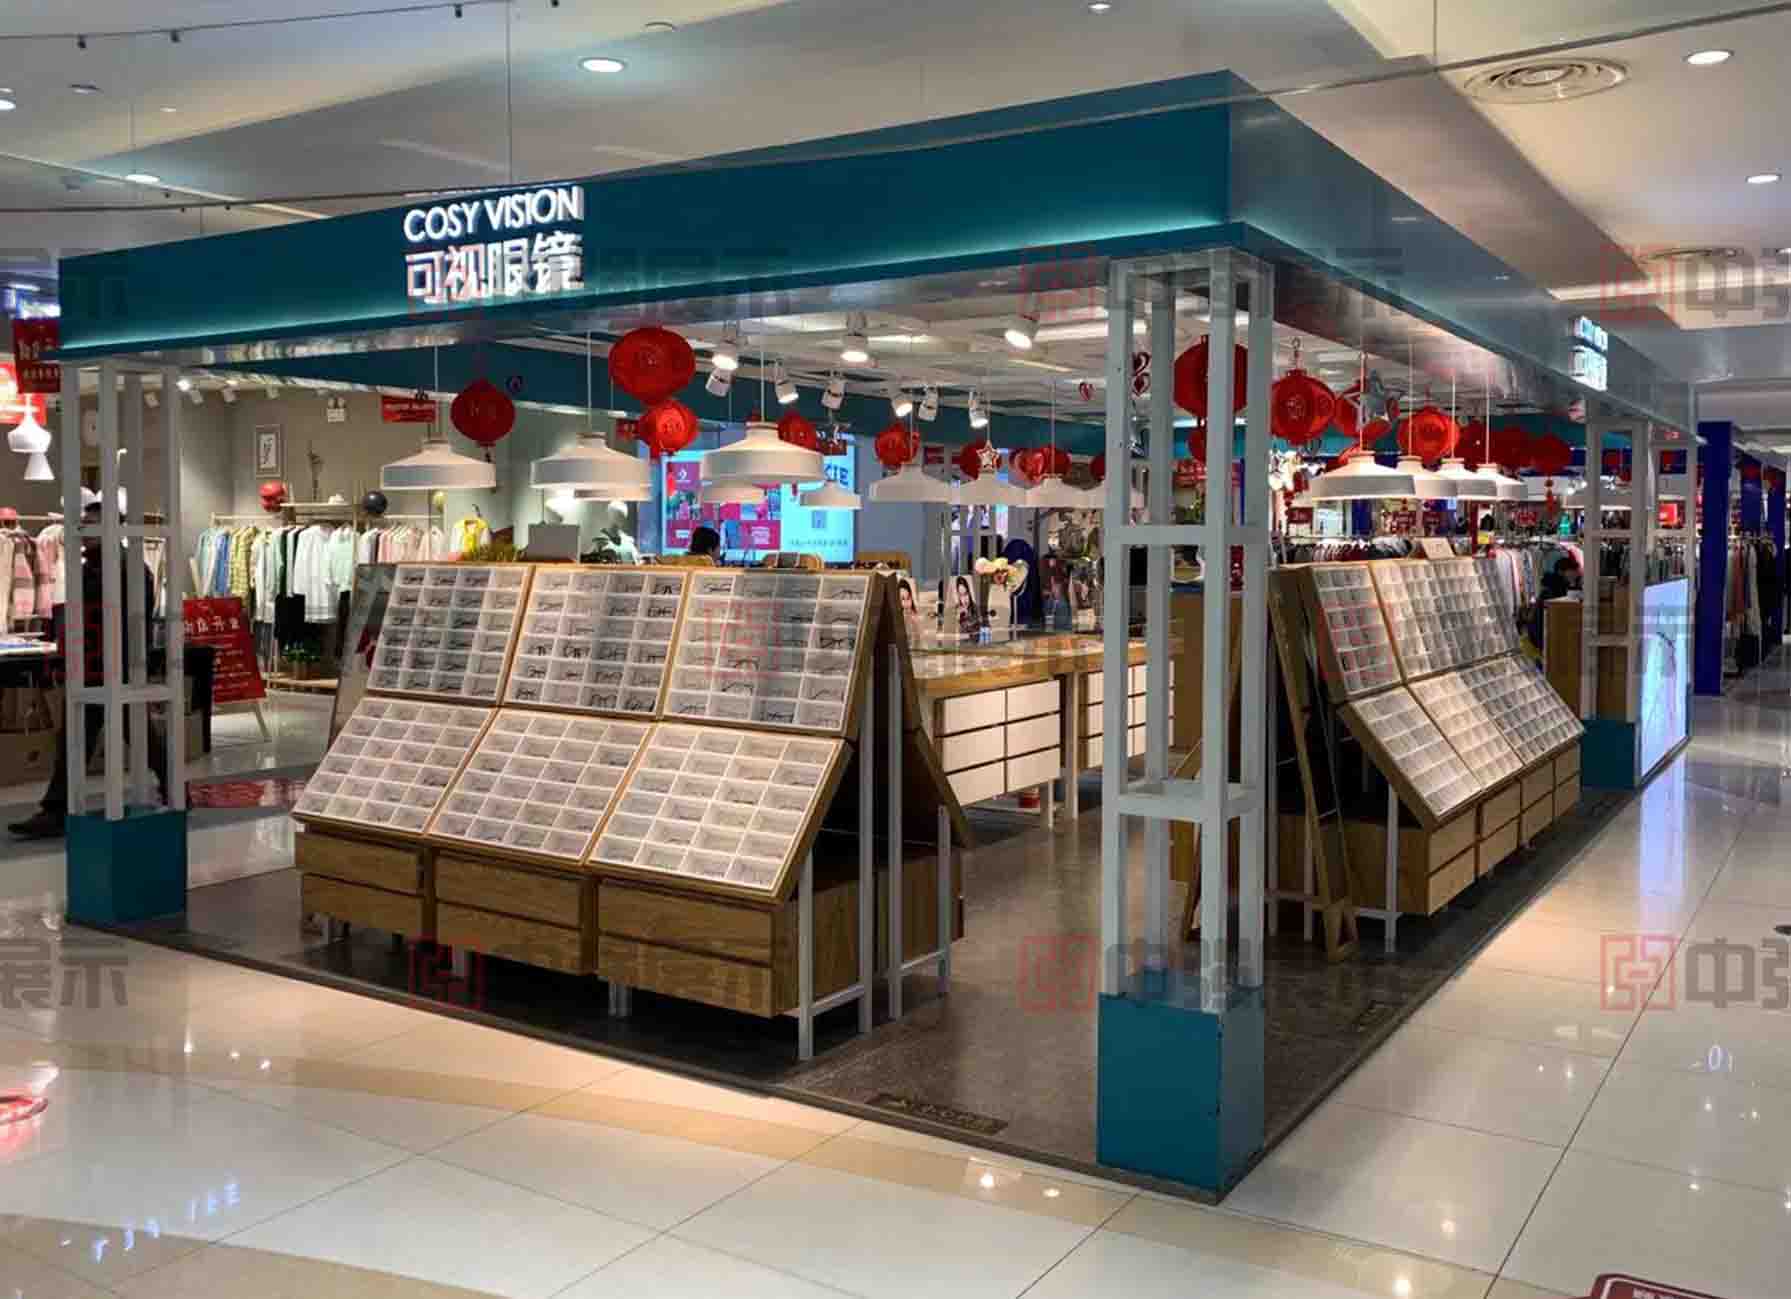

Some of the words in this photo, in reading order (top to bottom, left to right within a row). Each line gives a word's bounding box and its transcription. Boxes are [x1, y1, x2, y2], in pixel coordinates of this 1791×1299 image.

[404, 201, 481, 242] COSY
[484, 185, 585, 231] VISION
[404, 230, 585, 304] 可视眼镜
